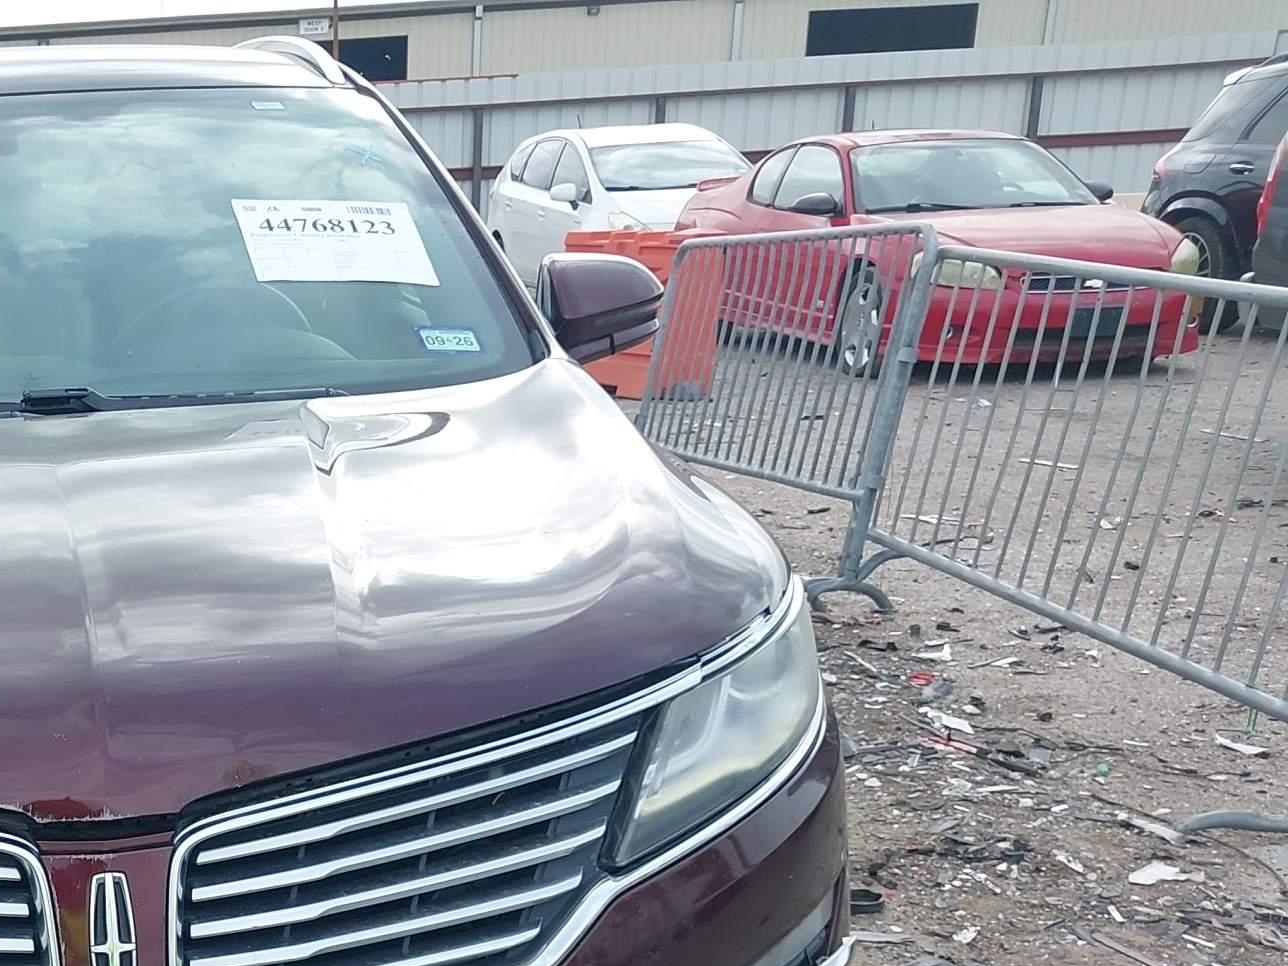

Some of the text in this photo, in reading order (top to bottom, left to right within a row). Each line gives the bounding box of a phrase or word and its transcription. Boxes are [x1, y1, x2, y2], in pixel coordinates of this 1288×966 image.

[259, 217, 396, 236] 44768123
[425, 335, 474, 347] 09 26
